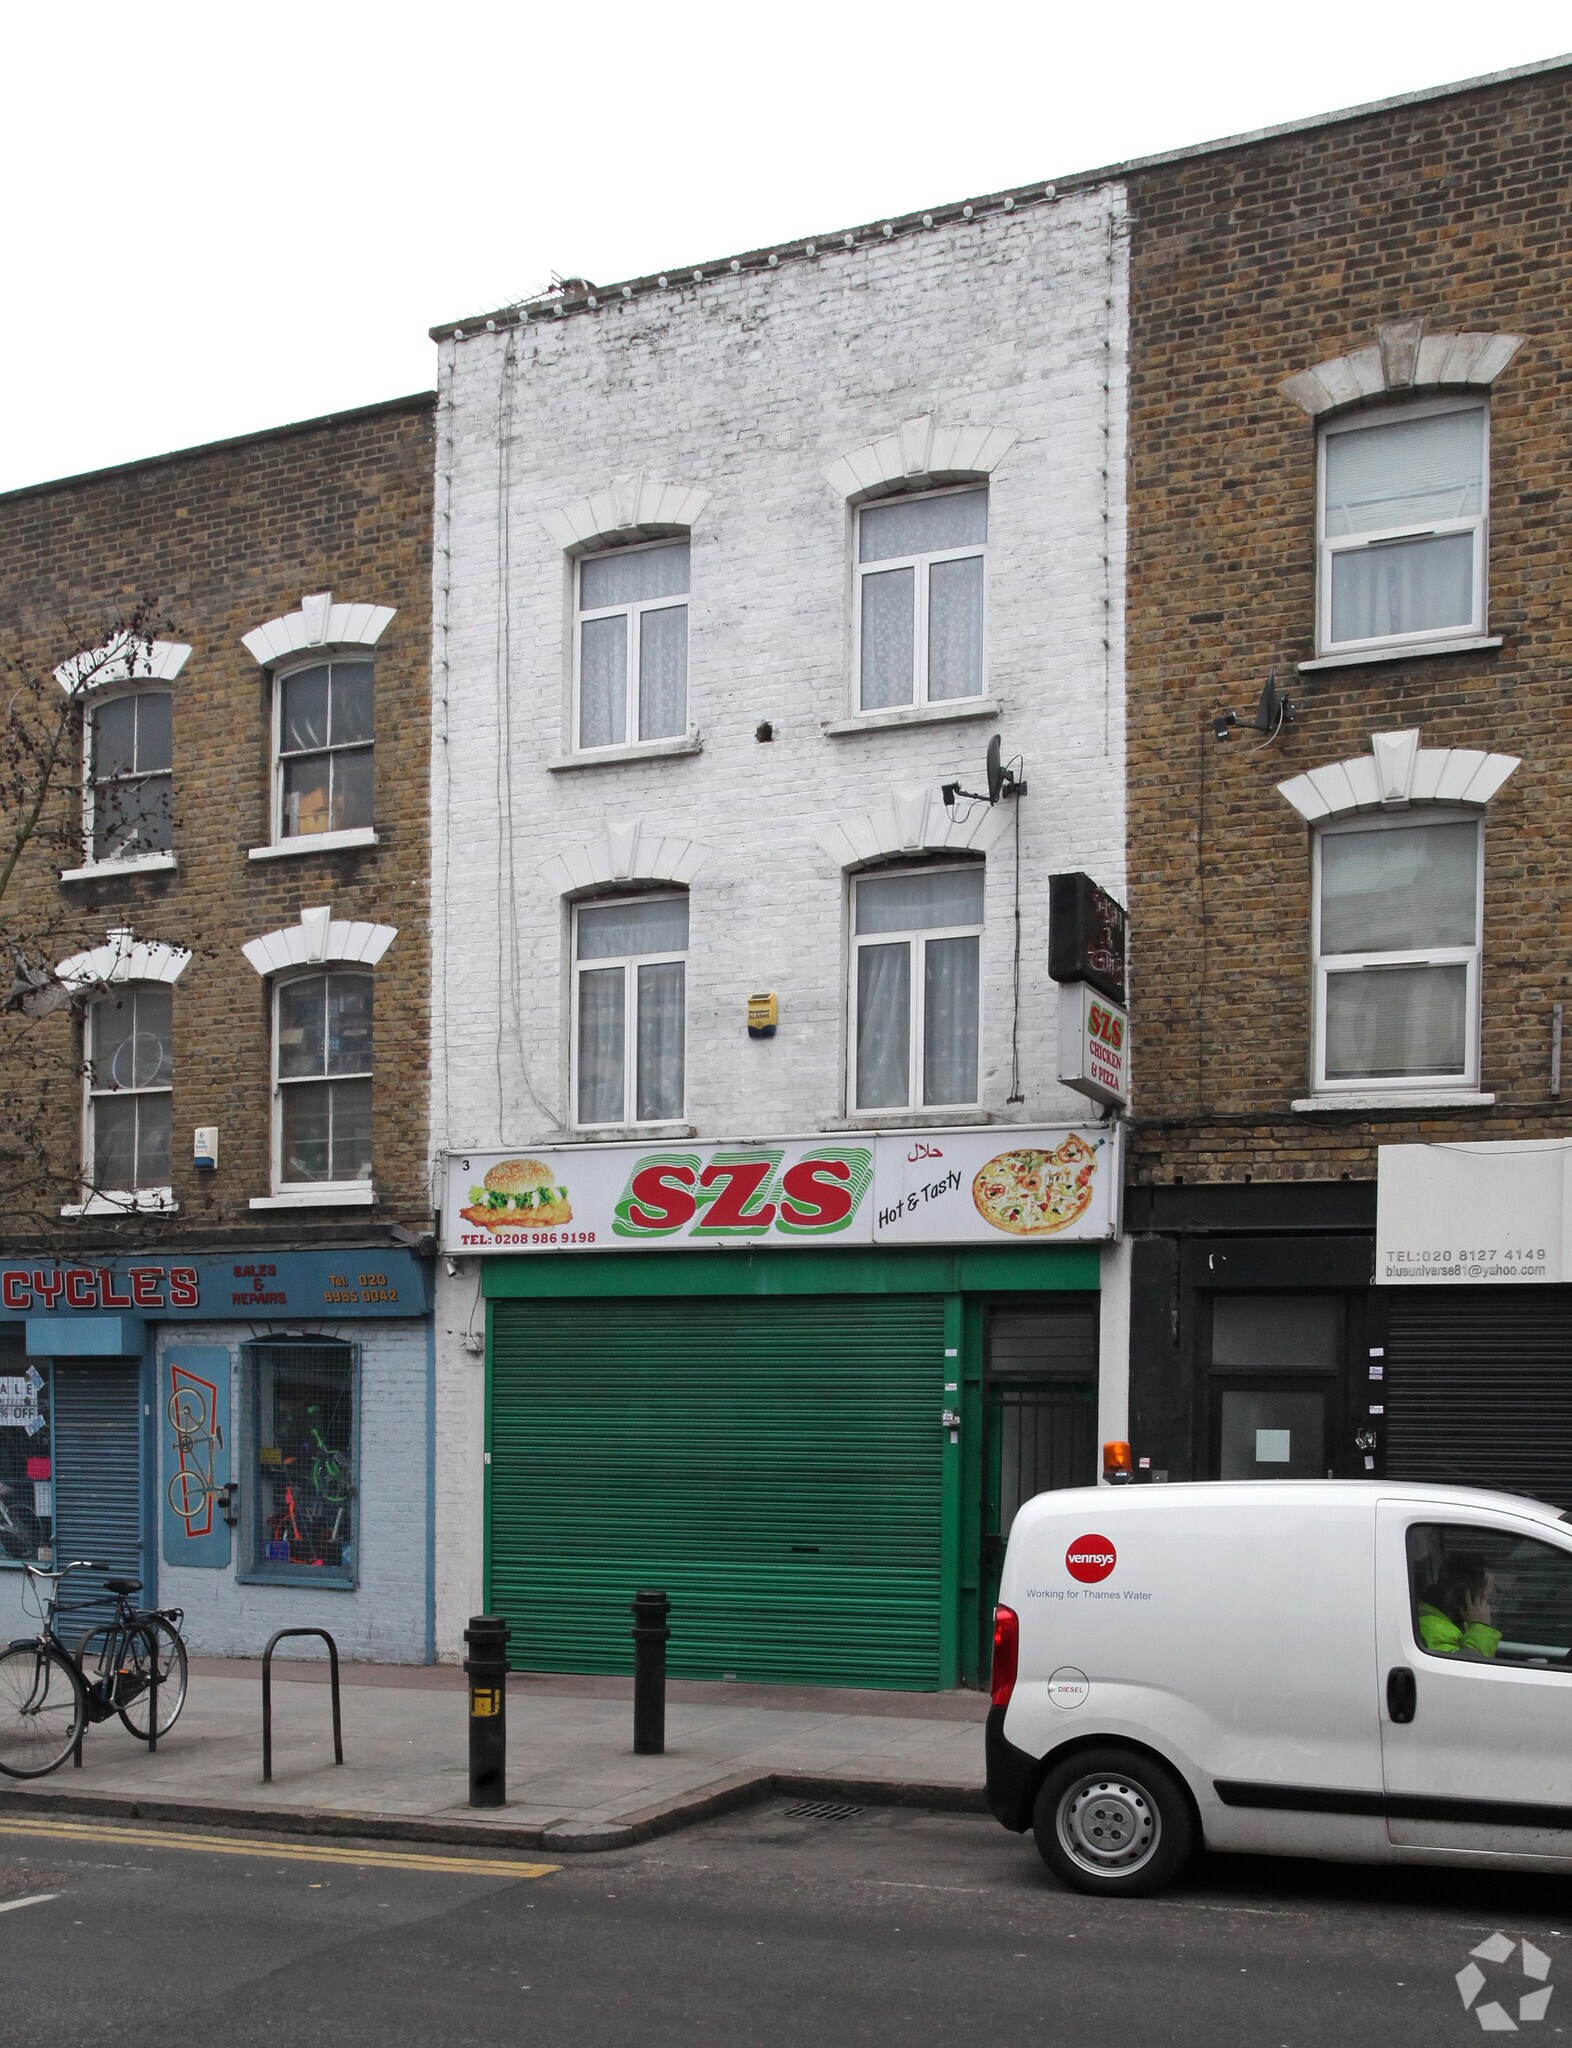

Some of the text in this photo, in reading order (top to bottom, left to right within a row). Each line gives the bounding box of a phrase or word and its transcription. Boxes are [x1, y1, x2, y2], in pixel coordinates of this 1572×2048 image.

[1088, 1001, 1124, 1051] SZS
[1090, 1040, 1122, 1071] CHICKEN
[1091, 1062, 1120, 1091] & PIZZA
[907, 1143, 944, 1163] حلال
[462, 1159, 471, 1171] 3
[624, 1156, 856, 1232] SZS
[878, 1170, 962, 1229] Hot & Tasty
[461, 1232, 596, 1245] TEL: 0208 986 9198
[1386, 1248, 1546, 1262] TEL:020 8127 4149
[233, 1264, 277, 1278] SALES
[2, 1266, 199, 1308] CYCLES
[358, 1274, 387, 1287] 020
[232, 1292, 287, 1305] REPAIRS
[361, 1289, 399, 1303] 0042
[0, 1383, 33, 1395] ALE
[1067, 1553, 1114, 1567] vennsys
[1026, 1589, 1153, 1600] Working for Thames Water
